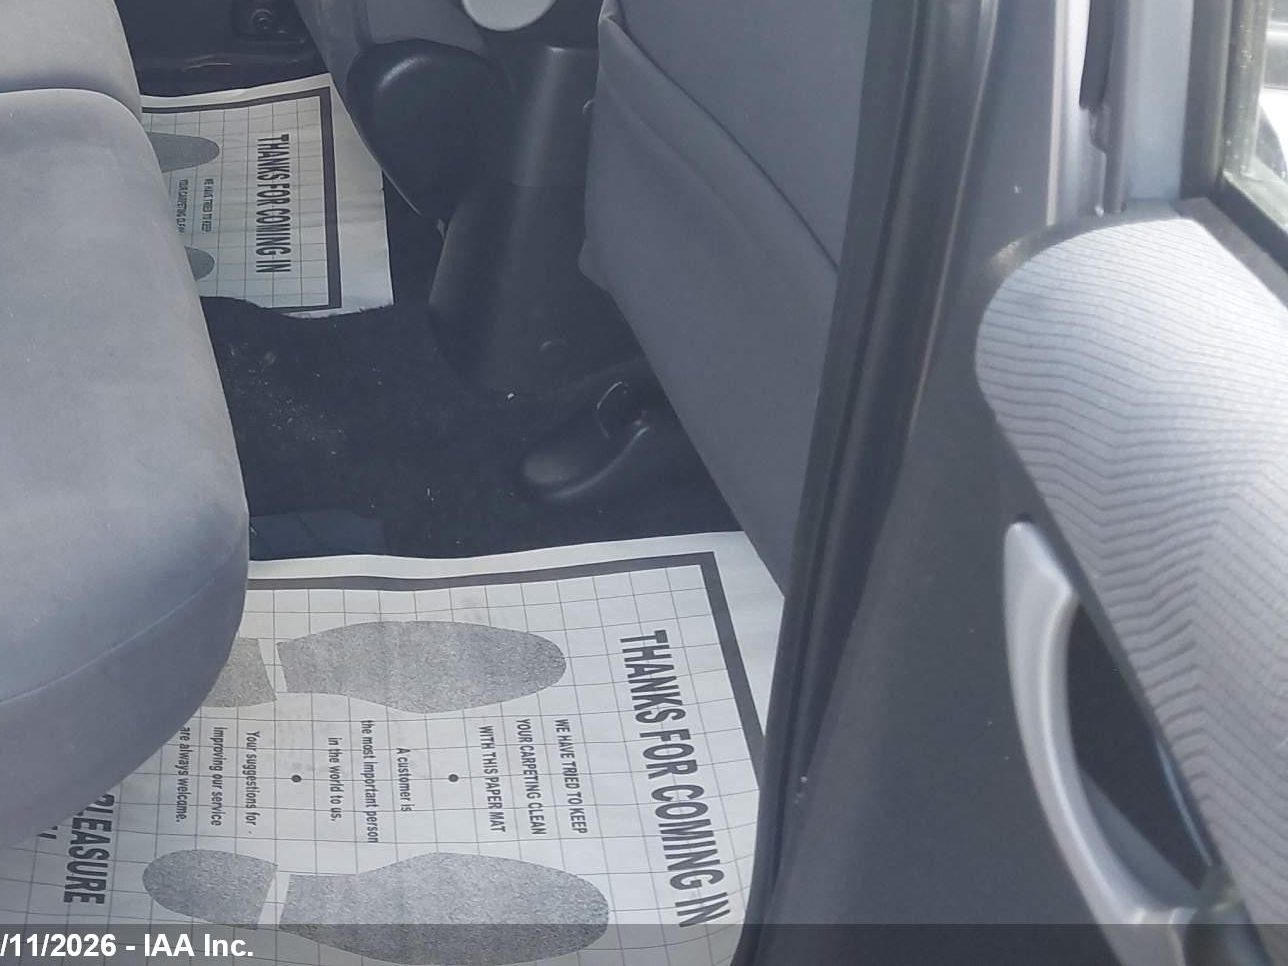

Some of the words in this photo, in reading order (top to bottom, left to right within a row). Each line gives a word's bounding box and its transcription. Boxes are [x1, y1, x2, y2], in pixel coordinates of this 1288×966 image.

[257, 134, 291, 181] THANKS
[257, 183, 291, 207] FOR
[256, 208, 292, 256] COMING
[256, 259, 292, 274] IN
[619, 629, 686, 725] THANKS
[361, 720, 377, 734] the
[516, 719, 533, 743] YOUR
[554, 718, 571, 733] WE
[245, 731, 261, 752] Your
[327, 737, 343, 746] in
[362, 736, 377, 759] most
[478, 726, 495, 750] WITH
[557, 735, 575, 759] HAVE
[175, 743, 193, 776] always
[328, 748, 344, 763] the
[396, 747, 411, 755] A
[639, 728, 699, 780] FOR
[482, 752, 499, 775] THIS
[519, 745, 541, 800] CARPETING
[560, 761, 580, 790] TRIED
[210, 774, 225, 790] our
[241, 753, 261, 809] suggestions
[328, 765, 345, 793] world
[359, 761, 379, 809] important
[397, 757, 413, 801] customer
[175, 777, 192, 824] welcome.
[329, 795, 344, 805] to
[484, 776, 503, 810] PAPER
[567, 792, 583, 806] TO
[210, 791, 226, 827] service
[245, 811, 261, 826] for
[329, 807, 344, 822] us.
[400, 803, 415, 812] is
[528, 802, 547, 835] CLEAN
[362, 811, 380, 844] person
[489, 811, 506, 833] MAT
[569, 807, 588, 834] KEEP
[651, 784, 725, 891] COMING
[675, 892, 731, 929] IN
